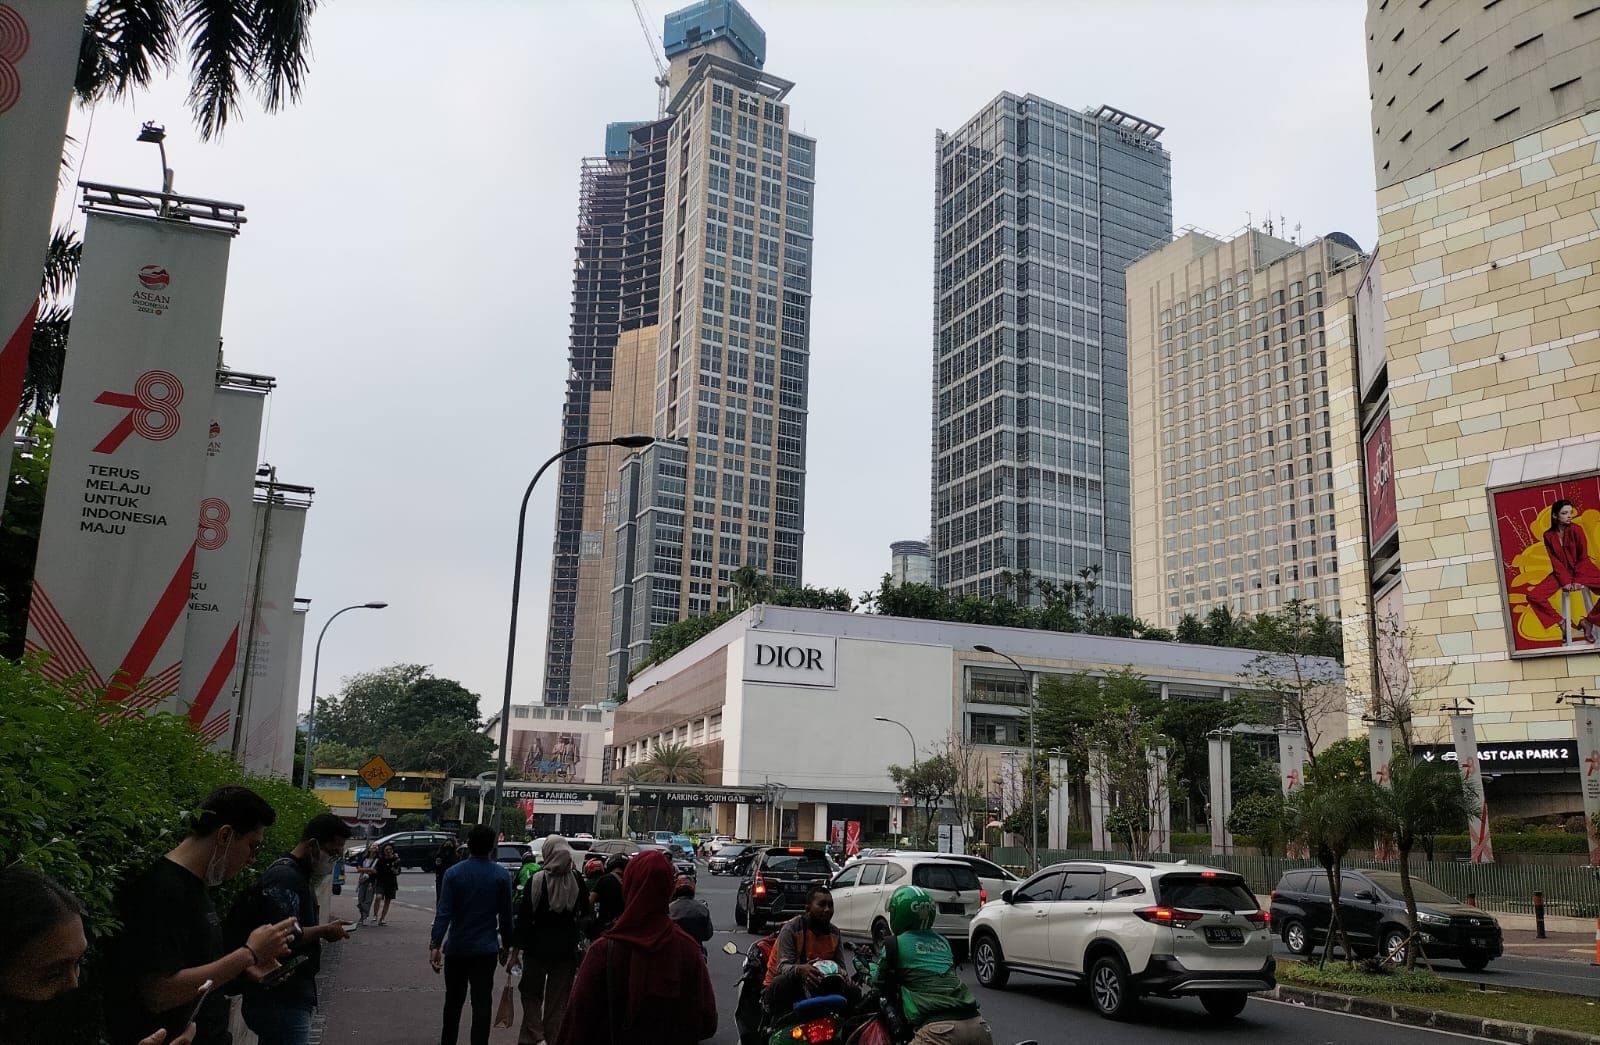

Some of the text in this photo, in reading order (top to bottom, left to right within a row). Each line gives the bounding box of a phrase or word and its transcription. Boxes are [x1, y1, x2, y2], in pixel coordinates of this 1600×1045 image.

[132, 290, 170, 304] ASEAN
[132, 299, 169, 310] INDONESIA
[137, 305, 154, 314] 2023
[92, 370, 184, 454] 78
[88, 464, 140, 480] TERUS
[86, 479, 151, 495] MELAJU
[84, 493, 140, 508] UNTUK
[82, 507, 167, 526] INDONESIA
[80, 521, 126, 535] MAJU
[754, 644, 824, 671] DIOR
[1477, 749, 1569, 761] AST CAR PARK 2
[520, 791, 539, 799] GATE
[545, 791, 578, 800] PARKING
[667, 792, 699, 801] PARKING
[704, 794, 727, 802] SOUTH
[727, 795, 746, 803] GATE
